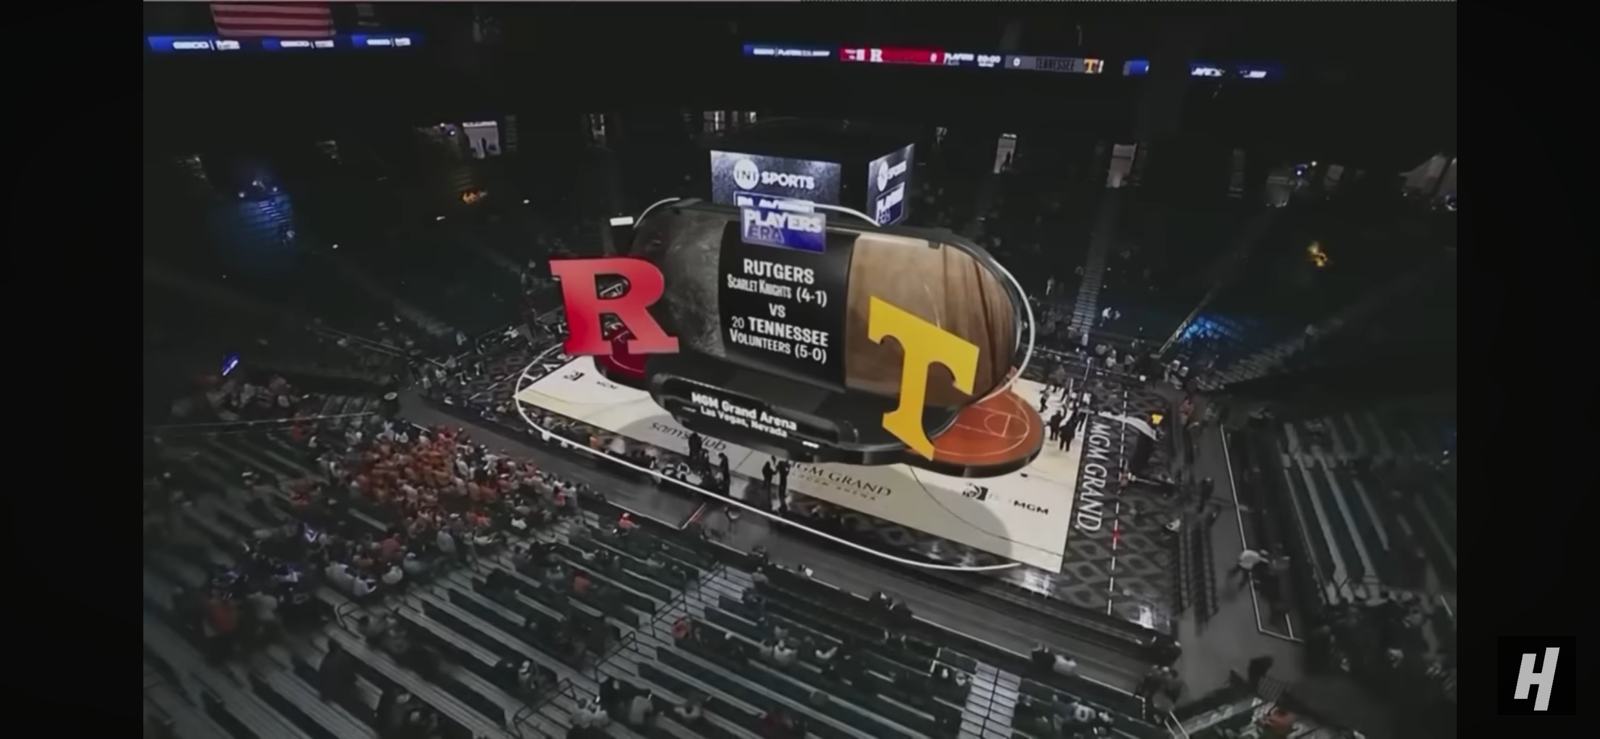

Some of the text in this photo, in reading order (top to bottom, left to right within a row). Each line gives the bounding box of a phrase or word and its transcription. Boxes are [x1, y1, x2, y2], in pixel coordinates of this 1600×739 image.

[761, 171, 815, 190] SPORTS
[828, 471, 892, 496] GRAND
[1077, 421, 1111, 531] MGM GRAND
